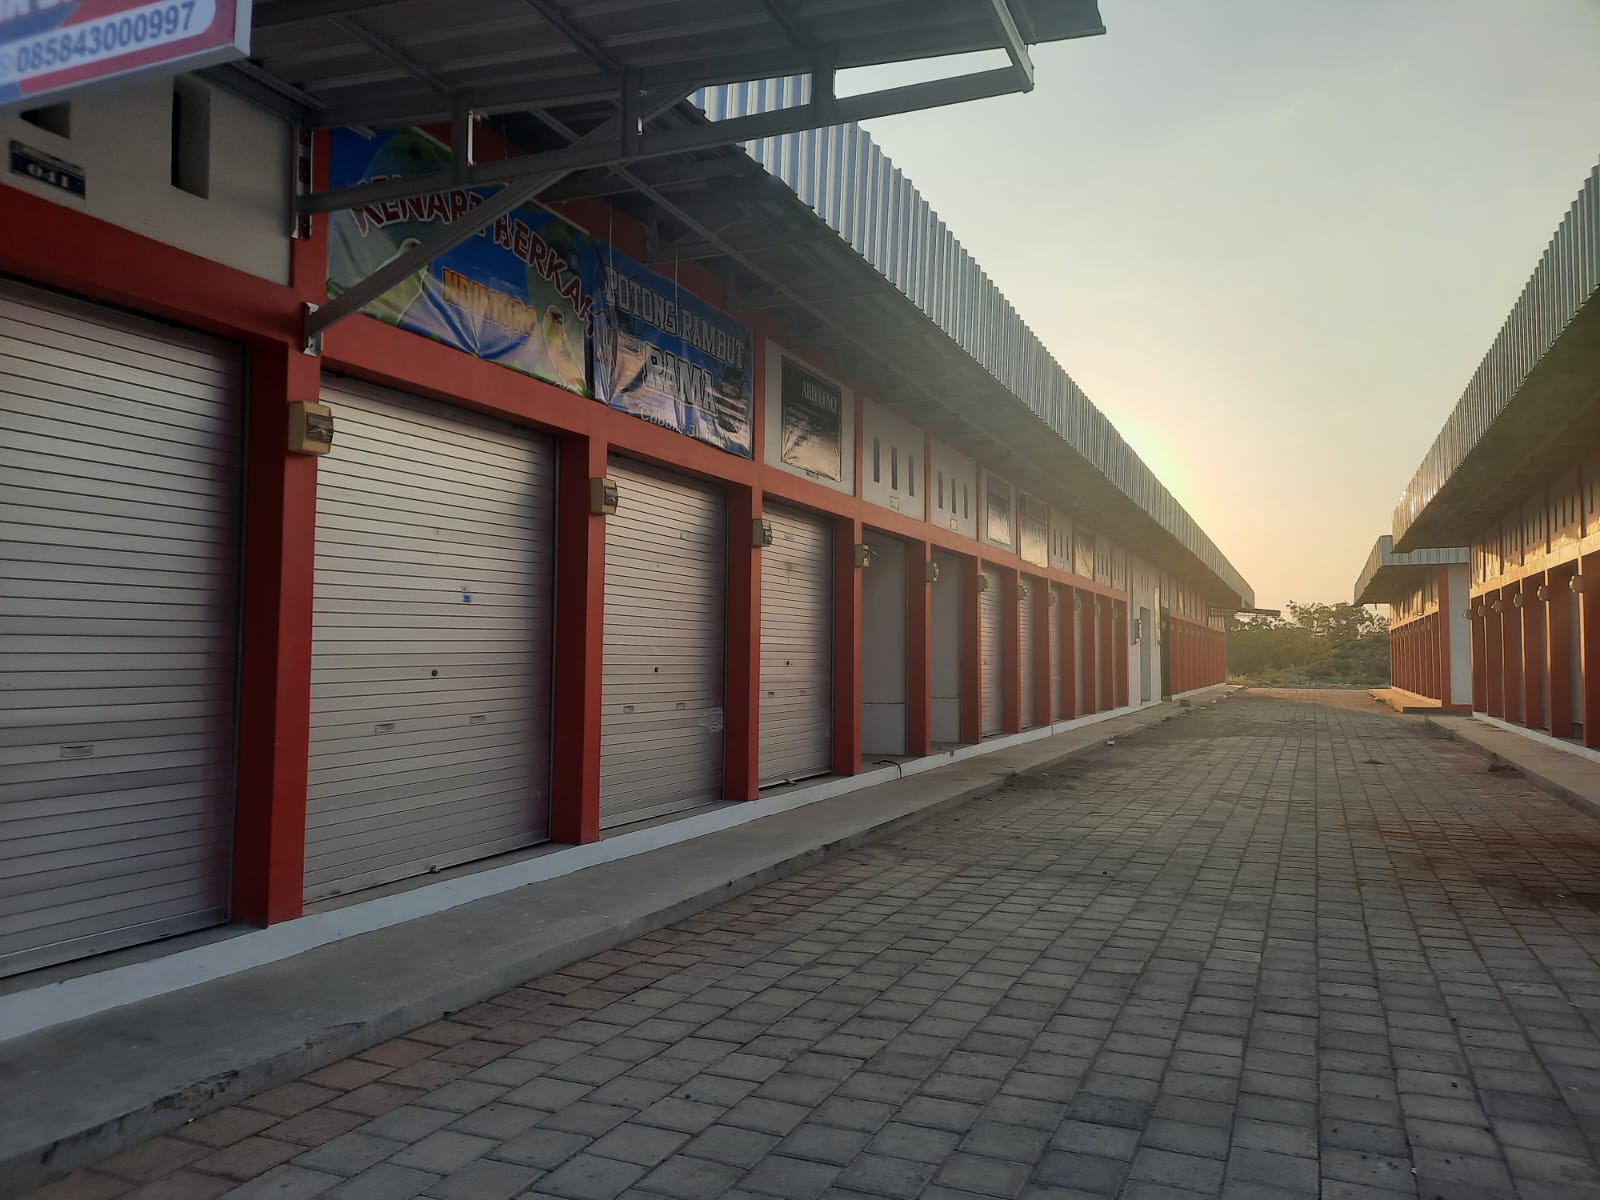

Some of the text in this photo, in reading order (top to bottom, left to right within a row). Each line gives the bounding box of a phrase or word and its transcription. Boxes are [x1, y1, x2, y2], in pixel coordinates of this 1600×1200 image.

[17, 1, 195, 72] 085843000997
[604, 266, 677, 336] POTONG
[680, 306, 745, 371] RAMBUT
[642, 341, 718, 416] RAMA
